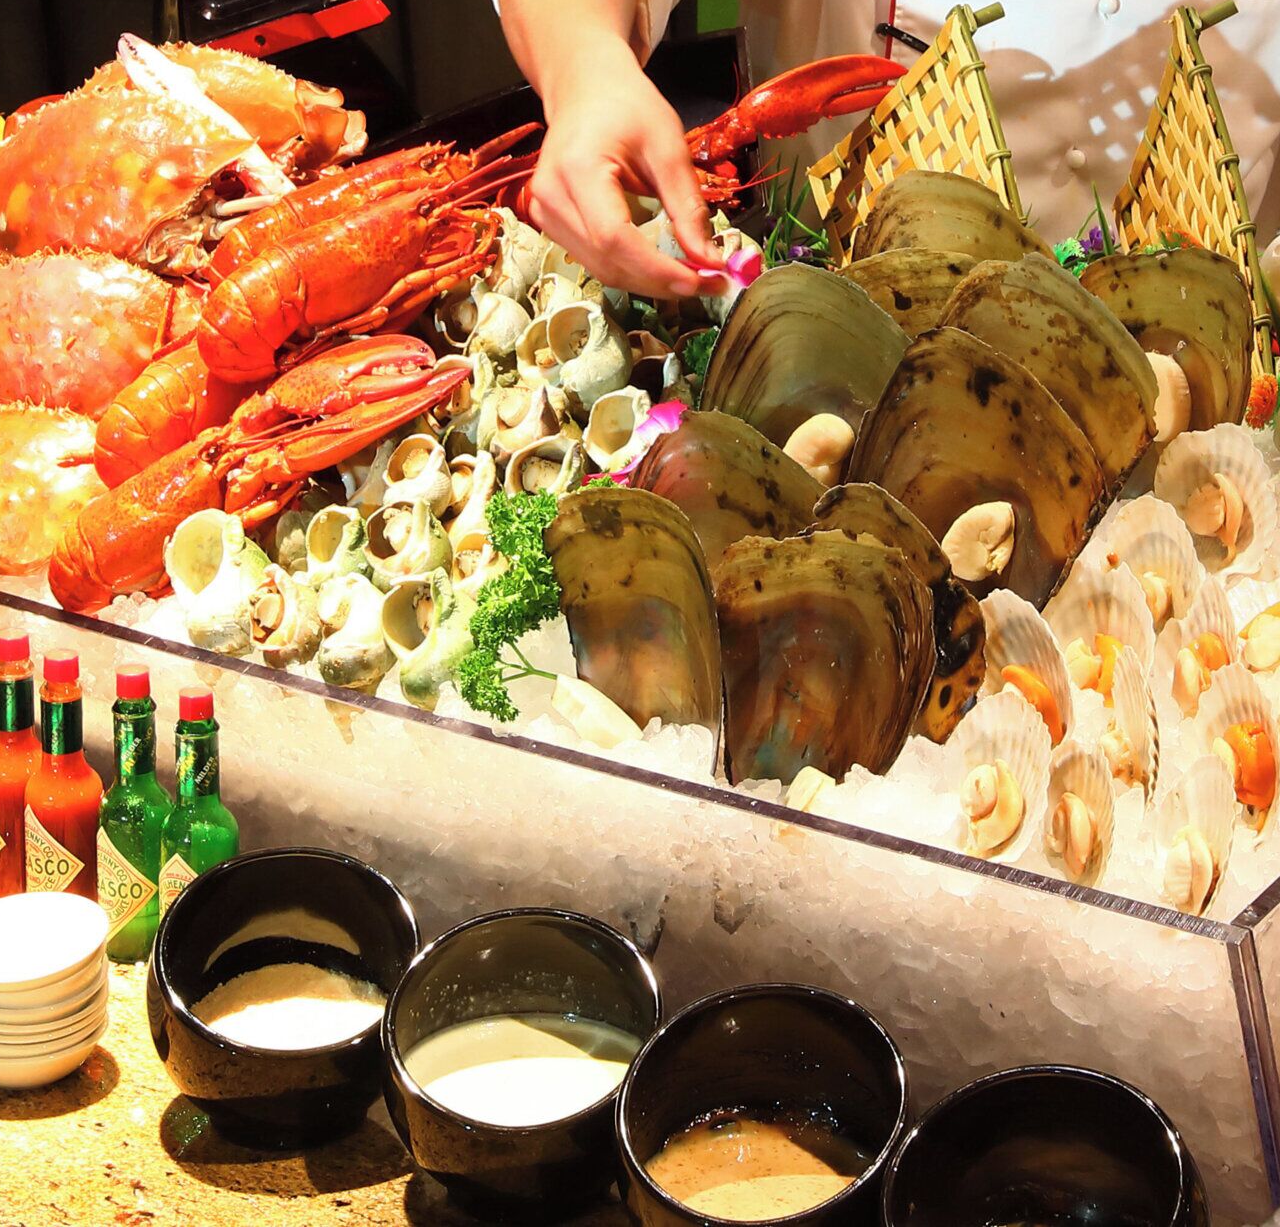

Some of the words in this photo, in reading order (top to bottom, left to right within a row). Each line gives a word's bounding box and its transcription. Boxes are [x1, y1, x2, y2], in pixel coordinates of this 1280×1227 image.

[121, 737, 142, 761] MILDER
[194, 756, 215, 785] MILDER
[26, 857, 69, 876] ASCO
[97, 882, 143, 900] ASCO
